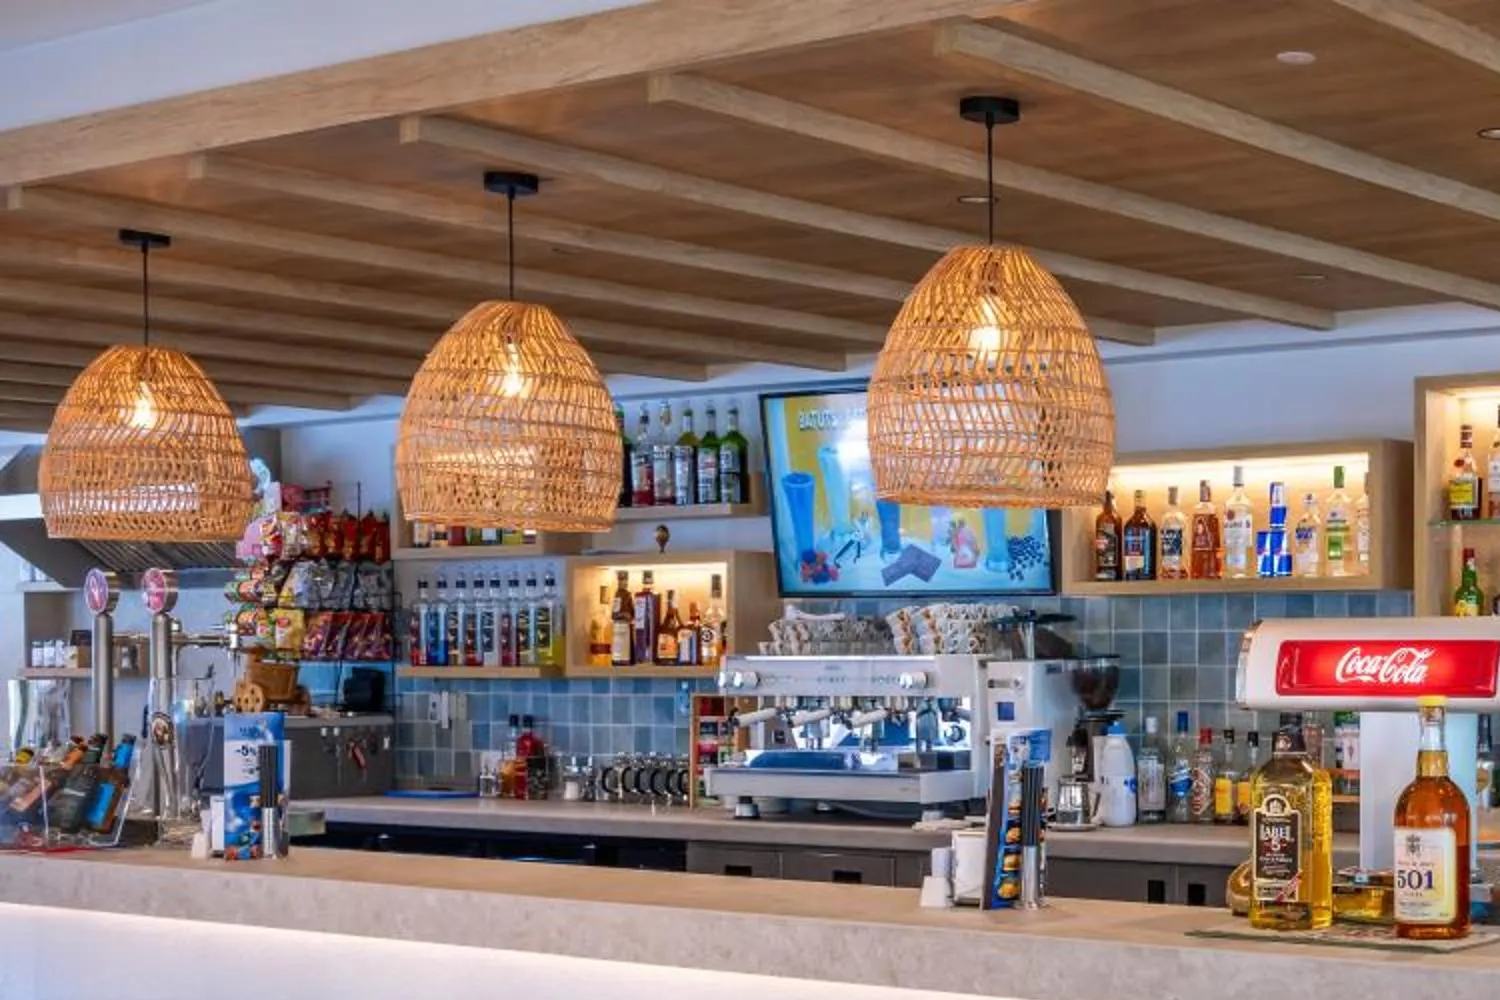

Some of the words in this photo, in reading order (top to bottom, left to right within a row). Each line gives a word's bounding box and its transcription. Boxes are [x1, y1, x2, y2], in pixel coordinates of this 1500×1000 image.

[1335, 647, 1436, 685] Coca-Cola
[1261, 823, 1292, 841] LABEL
[1397, 869, 1434, 890] 501
